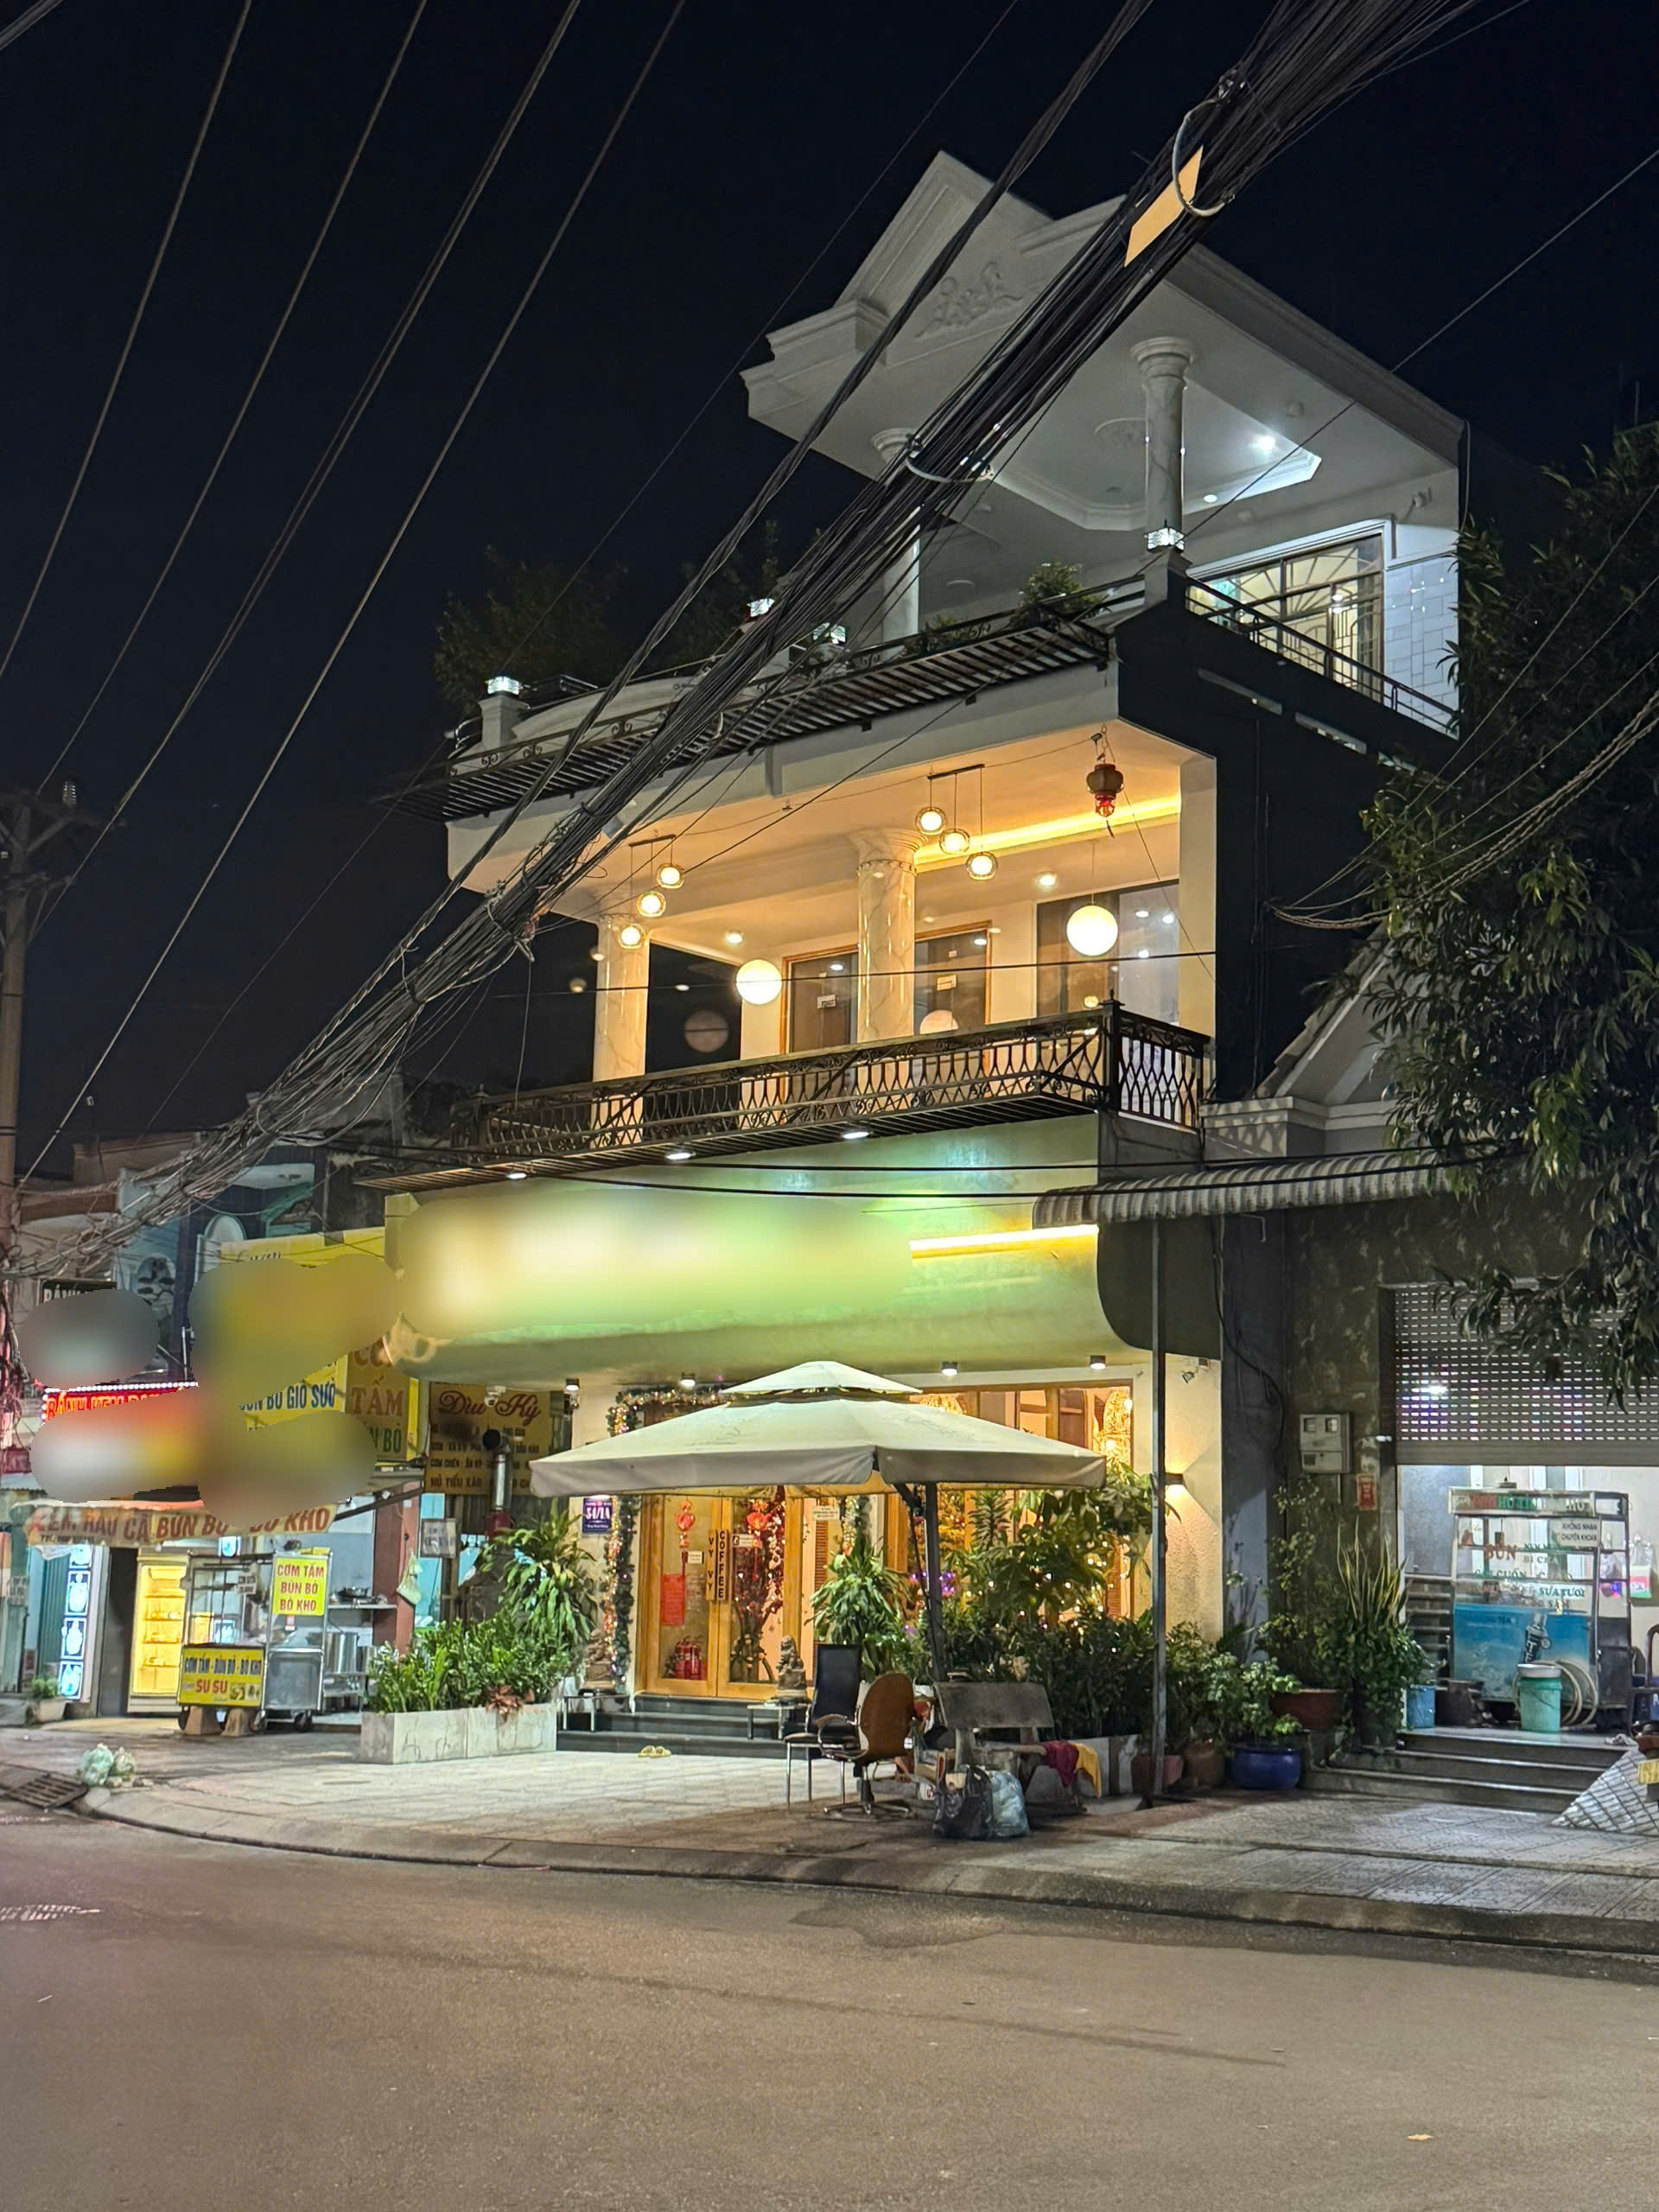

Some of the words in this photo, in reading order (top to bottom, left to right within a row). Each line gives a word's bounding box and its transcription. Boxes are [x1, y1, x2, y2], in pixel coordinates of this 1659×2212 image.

[351, 1374, 404, 1417] TẤM
[277, 1563, 301, 1577] CƠM
[303, 1561, 325, 1578] TẤM
[717, 1529, 726, 1599] COFFEE
[280, 1579, 302, 1594] BÚN
[304, 1580, 319, 1595] BÒ
[279, 1596, 294, 1611] BÒ
[296, 1599, 317, 1611] KHO
[195, 1678, 211, 1694] SU
[213, 1679, 228, 1694] SU
